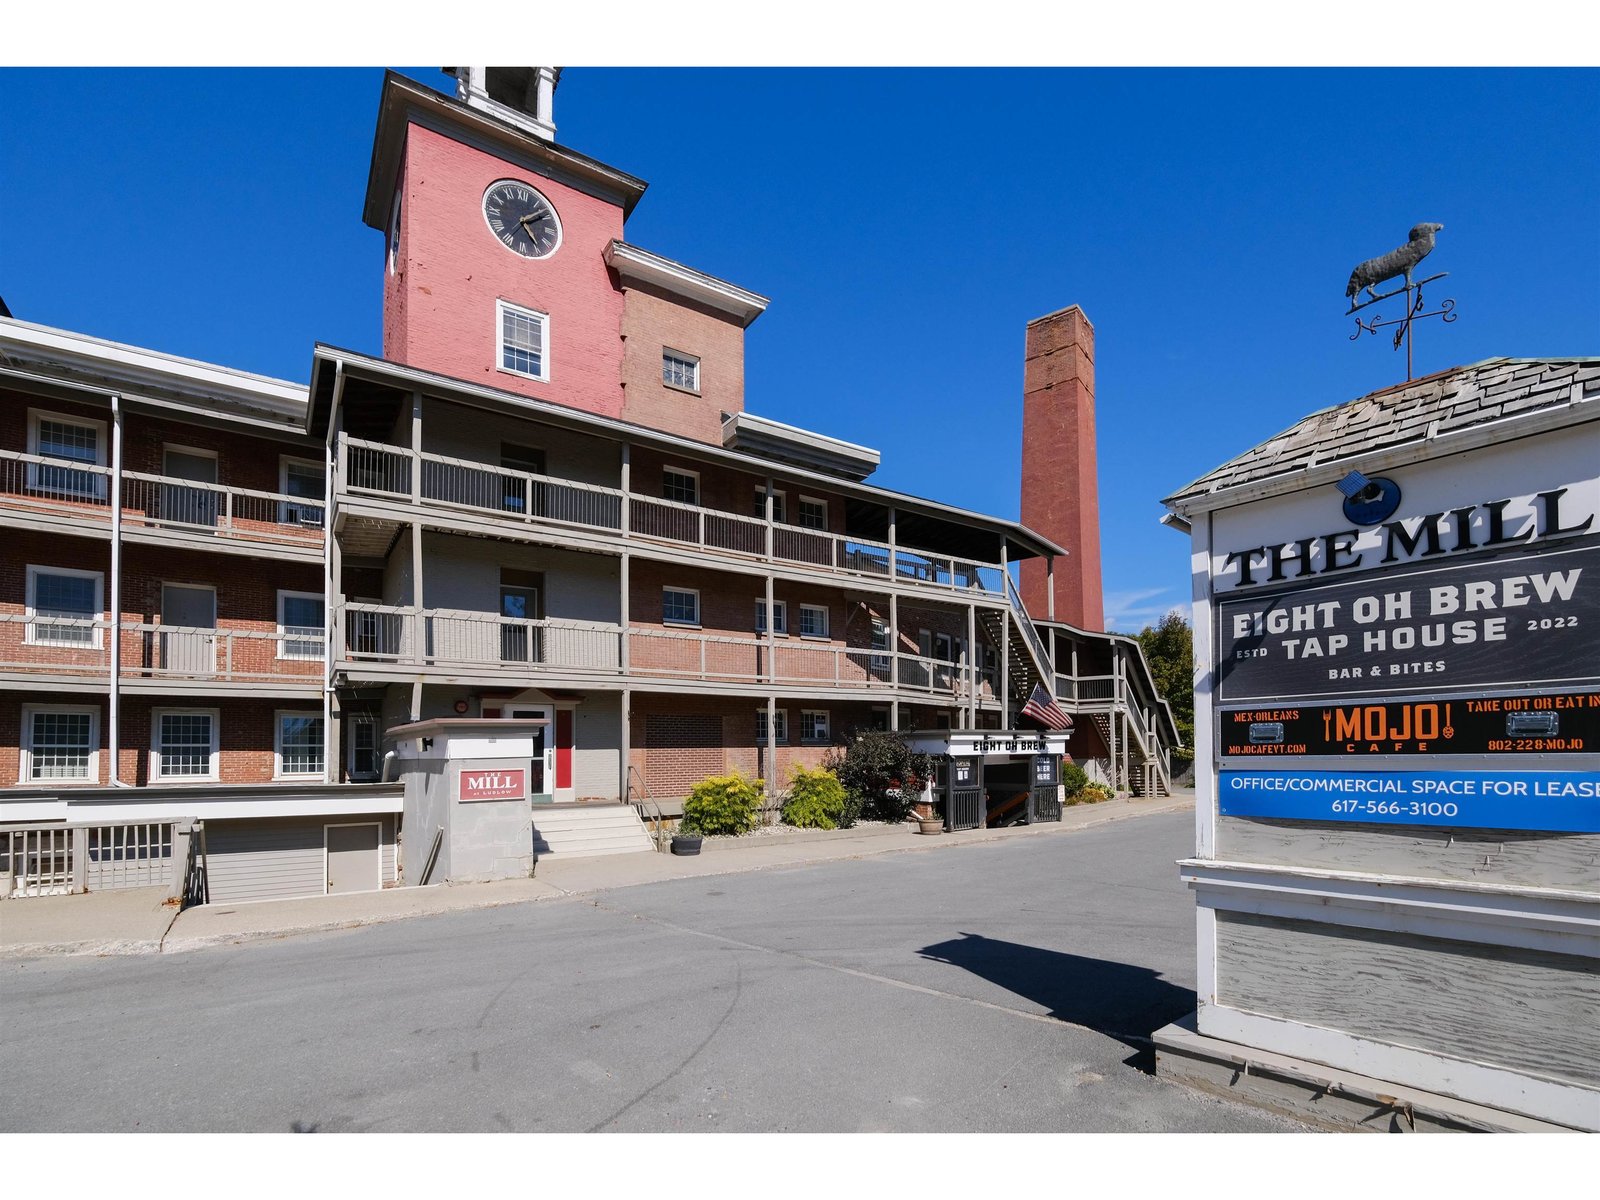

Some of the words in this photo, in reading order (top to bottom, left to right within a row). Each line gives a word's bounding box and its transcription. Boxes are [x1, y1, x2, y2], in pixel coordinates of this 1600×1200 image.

[517, 189, 529, 202] XII
[1225, 528, 1363, 588] THE
[1380, 488, 1595, 564] MILL
[1233, 600, 1342, 639] EIGHT
[1352, 590, 1412, 624] OH
[1429, 568, 1583, 616] BREW
[1527, 616, 1579, 631] 2022
[1281, 634, 1349, 660] TAP
[1363, 617, 1507, 652] HOUSE
[1236, 647, 1268, 659] ESTD
[1328, 667, 1363, 680] BAR
[1370, 665, 1382, 677] &
[1390, 661, 1447, 675] BITES
[1466, 700, 1500, 713] TAKE
[1503, 698, 1531, 711] OUT
[1533, 698, 1552, 710] OR
[1555, 696, 1584, 709] EAT
[973, 740, 1002, 751] EIGHT
[1005, 741, 1018, 751] OH
[1021, 740, 1047, 751] BREW
[1228, 744, 1306, 755] MOJOCAFEVT.COM
[1346, 742, 1427, 752] CAFE
[467, 776, 518, 790] MILL
[1231, 777, 1407, 793] OFFICE/COMMERCIAL
[1411, 780, 1476, 795] SPACE
[1482, 781, 1528, 796] FOR
[1331, 799, 1458, 816] 617-566-3100
